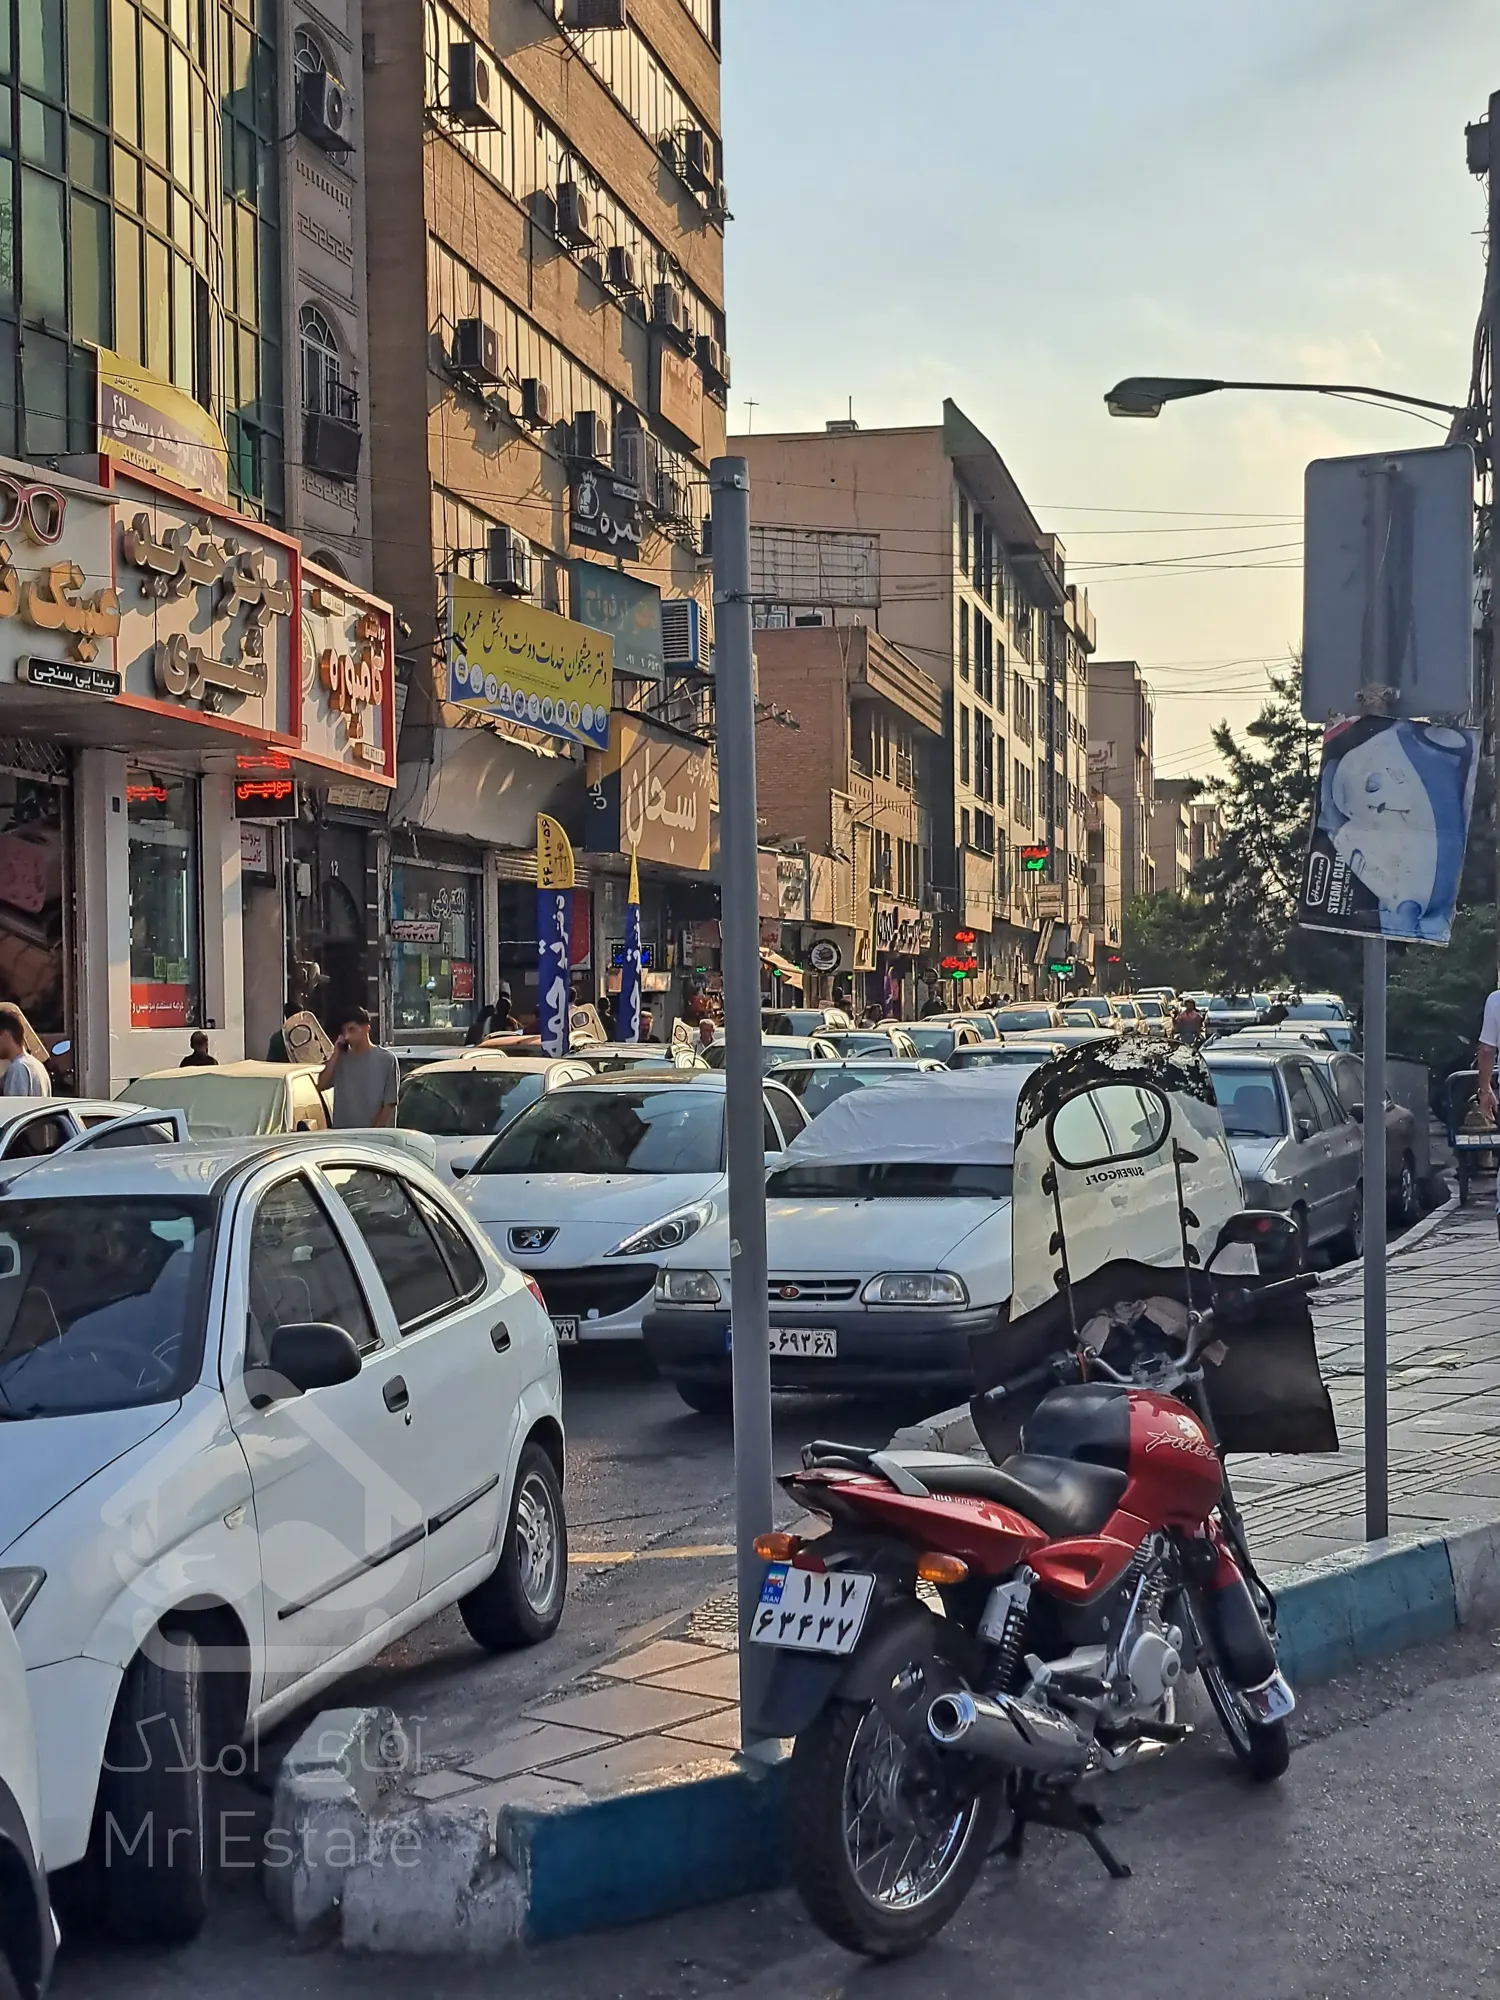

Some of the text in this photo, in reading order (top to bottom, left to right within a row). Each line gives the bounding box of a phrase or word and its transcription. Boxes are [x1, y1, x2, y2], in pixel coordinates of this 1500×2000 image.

[126, 512, 226, 598] خرید
[29, 560, 121, 663] عینک
[508, 632, 537, 660] دولت
[535, 641, 566, 670] خدمات
[564, 637, 592, 682] پیشخوان
[34, 665, 115, 694] بینایی سنجی
[588, 652, 608, 689] دفتر
[237, 781, 292, 799] سوسیس
[626, 747, 697, 854] سبحان
[331, 860, 339, 876] 12
[1327, 881, 1343, 914] STEAM
[779, 1332, 811, 1352] ۶۹۳
[814, 1337, 834, 1354] ۶۸
[762, 1594, 780, 1604] IRAN
[803, 1574, 856, 1608] ۱۱۷
[756, 1609, 853, 1645] ۶۳۴۳۷
